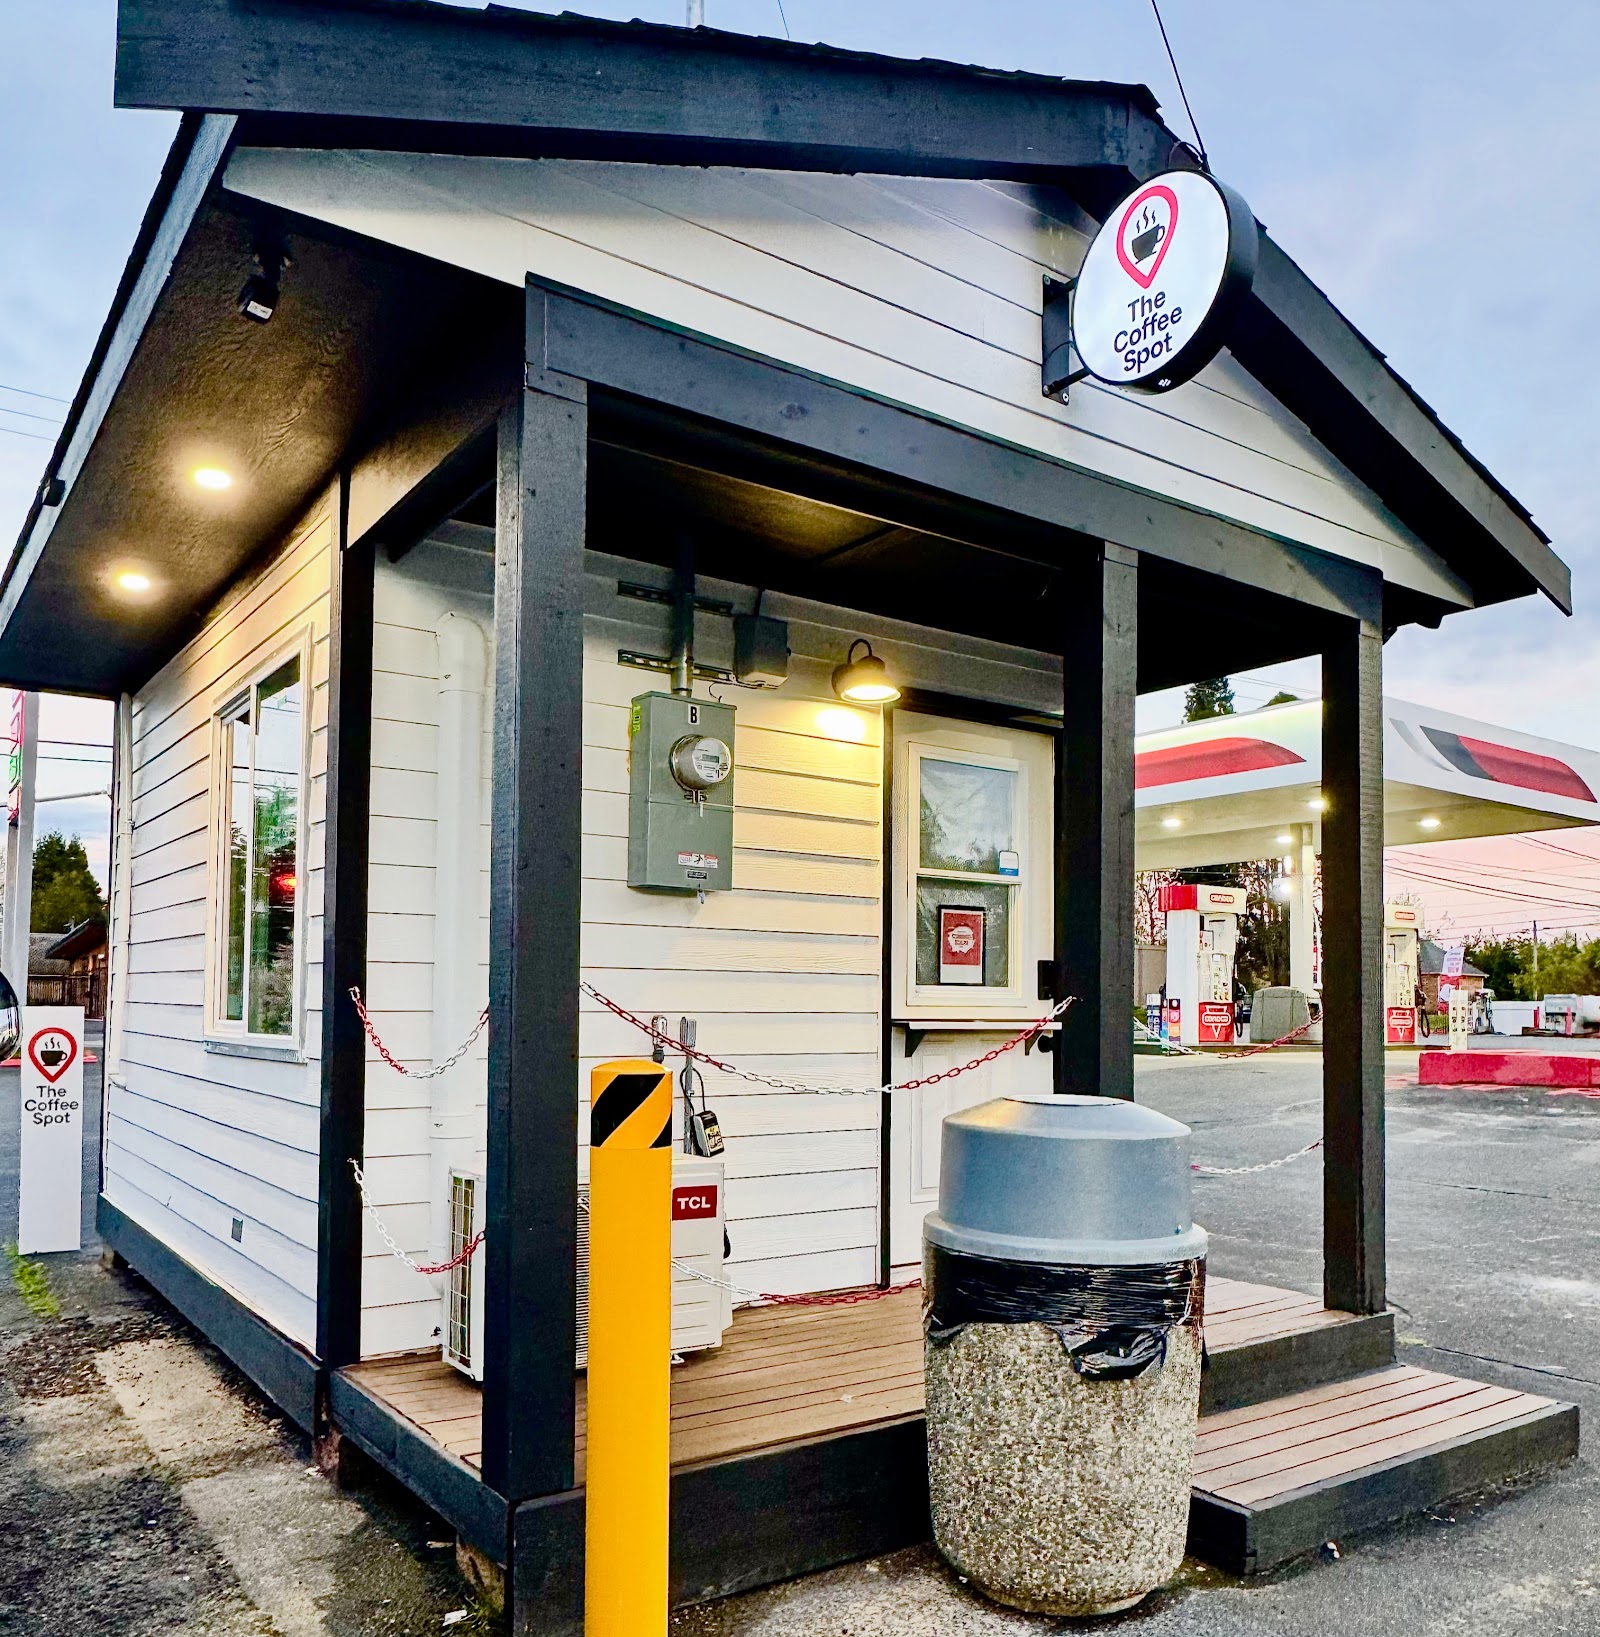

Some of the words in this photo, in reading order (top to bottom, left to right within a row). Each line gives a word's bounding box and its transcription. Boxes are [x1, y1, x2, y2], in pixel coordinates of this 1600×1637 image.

[1128, 291, 1166, 322] The
[1114, 306, 1183, 353] Coffee
[1123, 332, 1173, 373] Spot
[690, 706, 698, 723] B
[36, 1085, 67, 1098] The
[24, 1098, 79, 1112] Coffee
[33, 1112, 71, 1127] Spot
[677, 1196, 711, 1210] TCL
